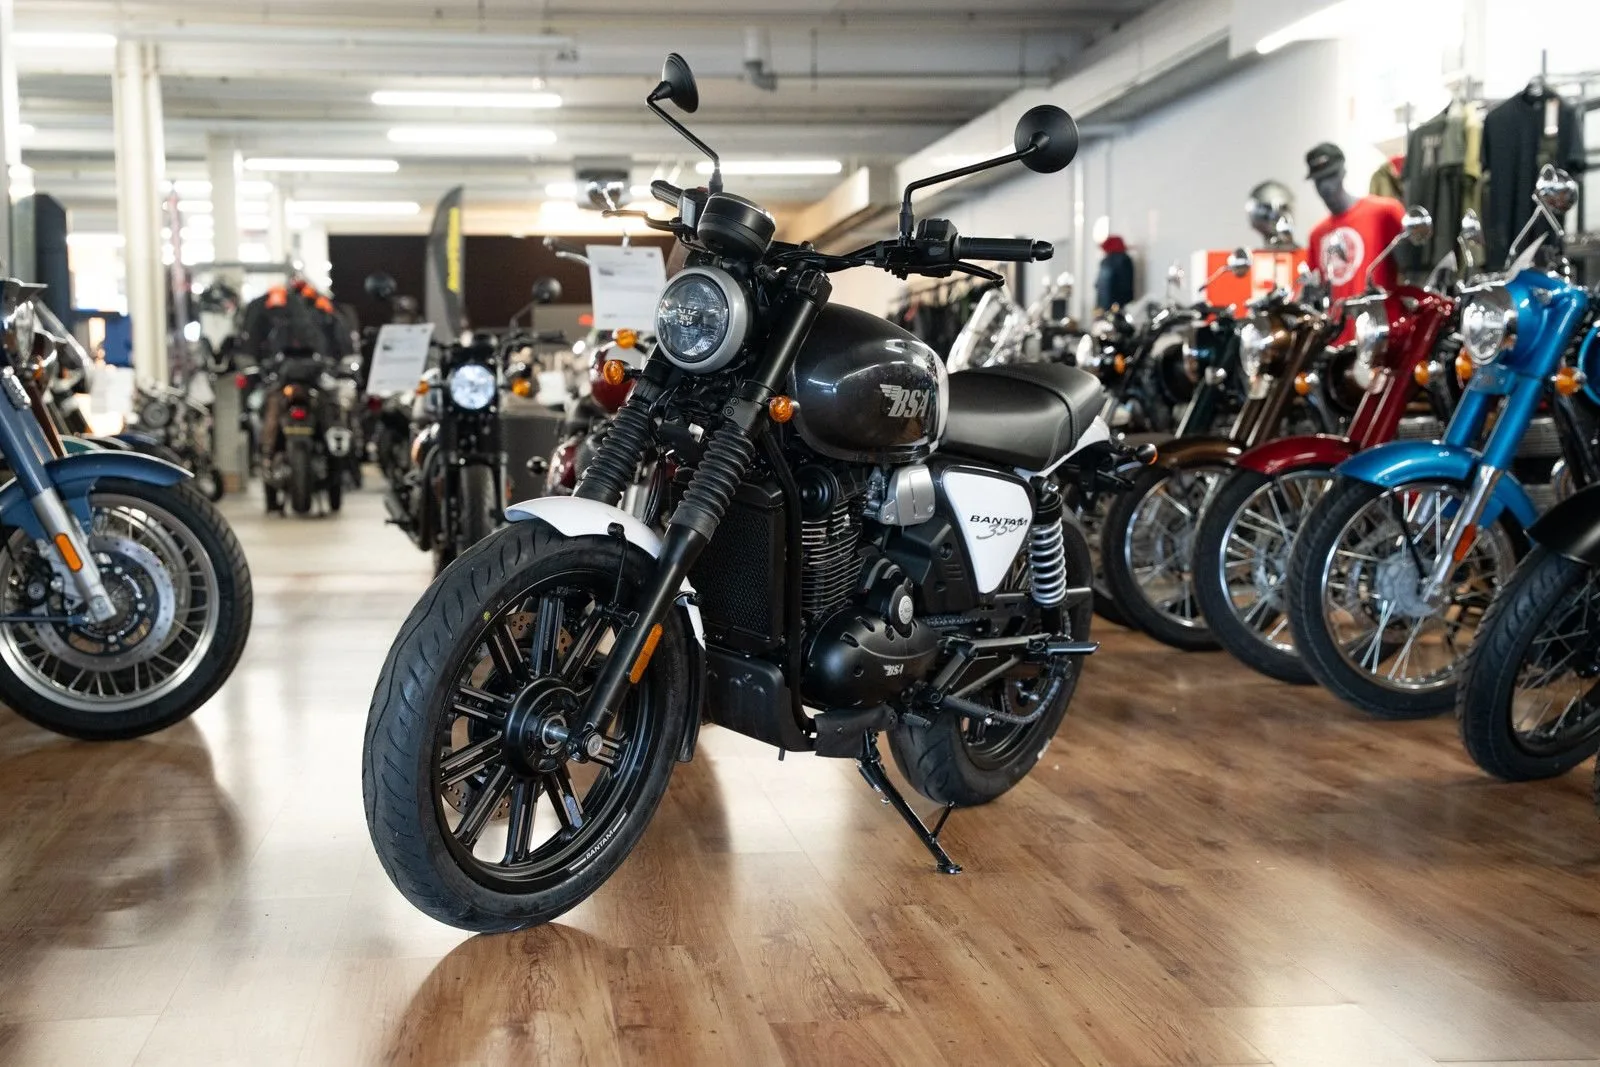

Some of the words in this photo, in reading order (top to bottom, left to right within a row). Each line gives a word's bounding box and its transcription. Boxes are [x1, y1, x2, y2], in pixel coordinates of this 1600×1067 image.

[887, 388, 930, 418] BSA
[970, 515, 1028, 526] BANTAM
[976, 520, 1023, 540] 350
[586, 831, 613, 859] BANTAM
